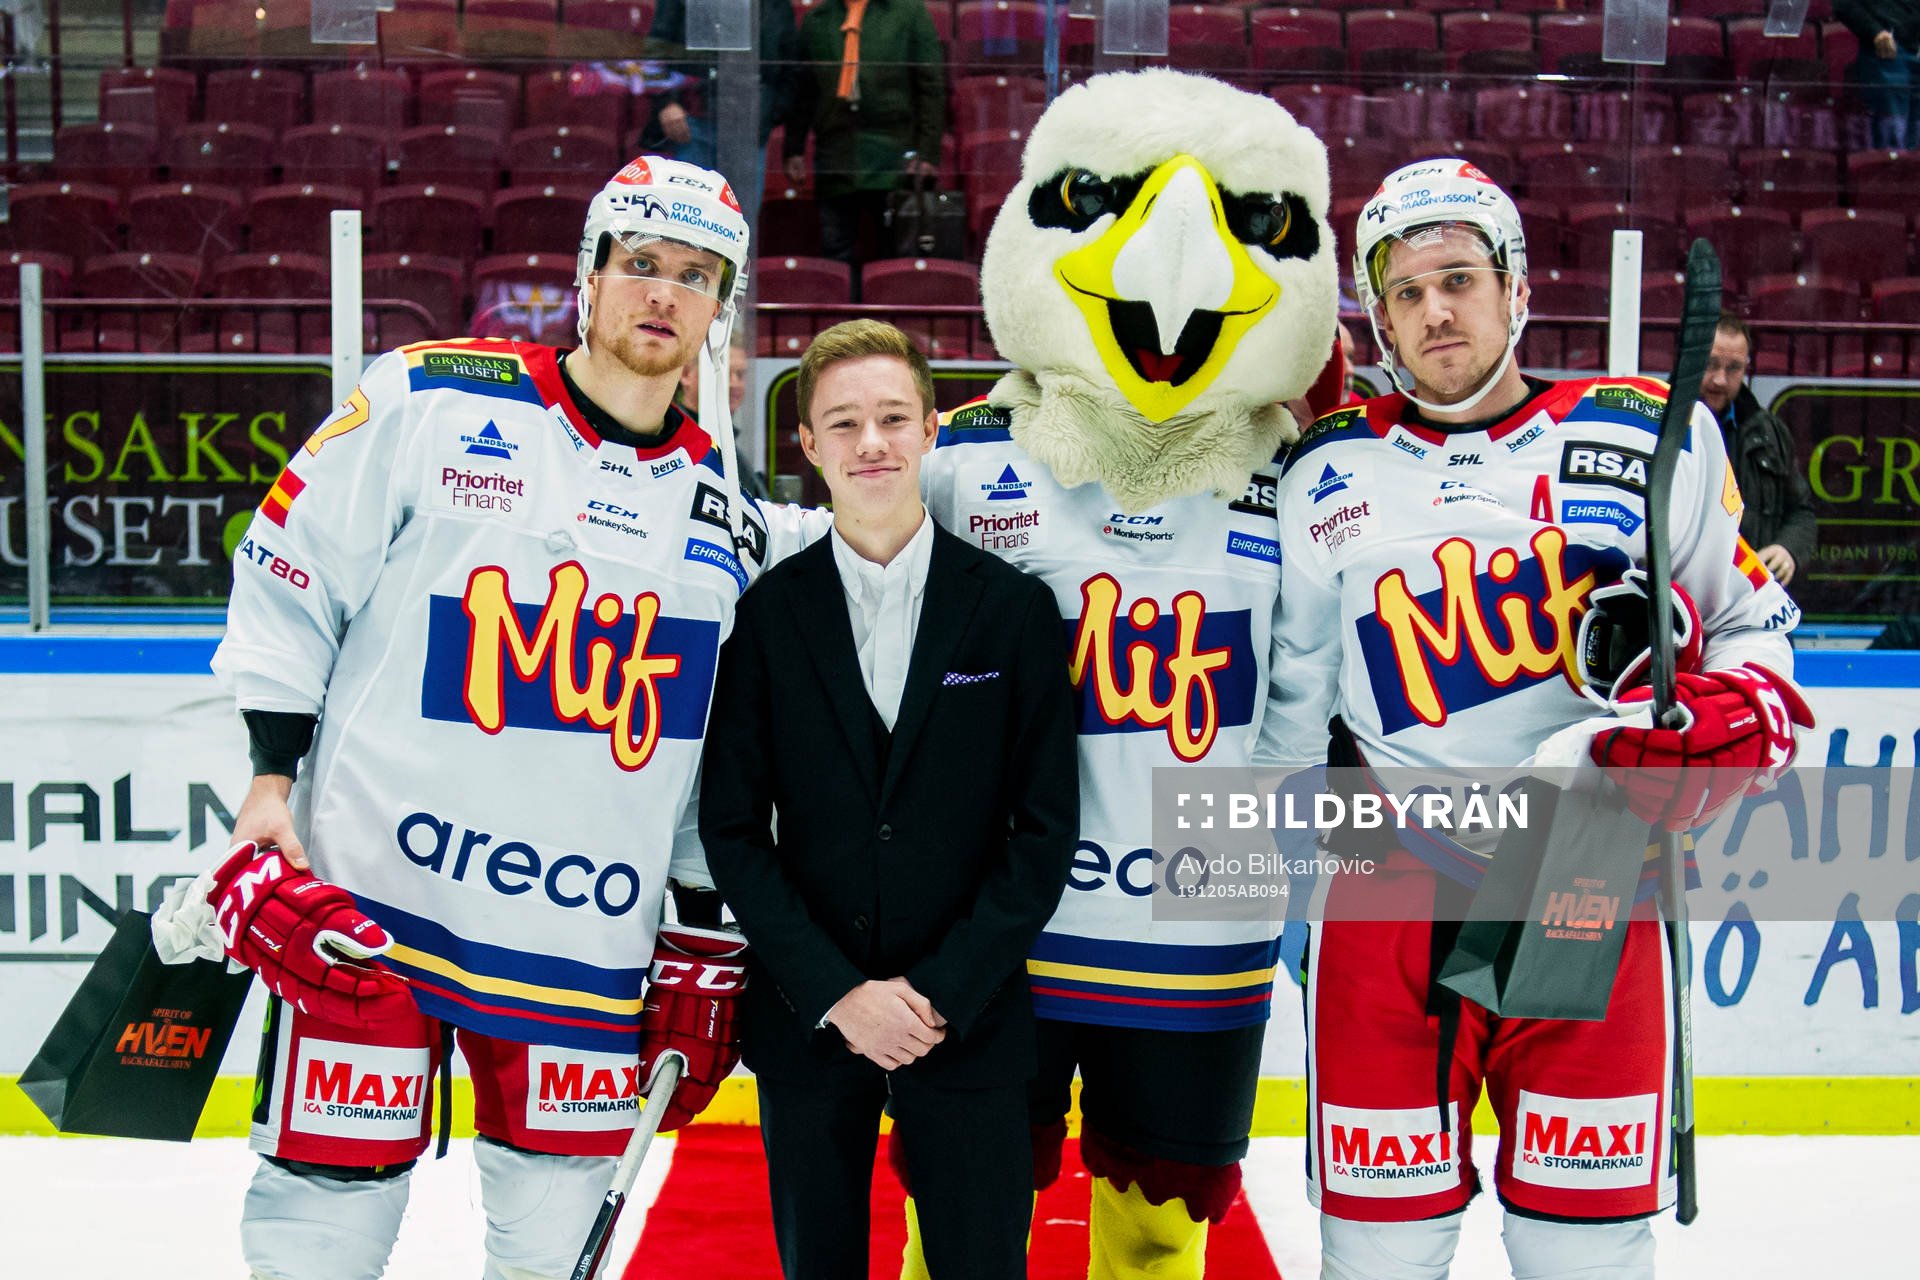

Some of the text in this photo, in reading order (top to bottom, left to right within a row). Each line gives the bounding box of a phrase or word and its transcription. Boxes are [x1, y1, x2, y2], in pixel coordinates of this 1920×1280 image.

[1400, 189, 1430, 203] OTTO
[1400, 194, 1477, 212] MAGNUSSON
[672, 202, 702, 217] OTTO
[669, 211, 736, 241] MAGNUSSON
[429, 355, 511, 371] GRÖNSAKS
[451, 364, 501, 380] HUSET
[460, 435, 519, 451] ERLANDSSON
[1394, 434, 1428, 457] bergx
[1506, 424, 1543, 450] bergx
[600, 460, 633, 477] SHL
[650, 457, 684, 478] bergx
[1447, 453, 1484, 467] SHL
[1569, 450, 1647, 485] RSA
[441, 468, 524, 497] Prioritet
[981, 481, 1032, 491] ERLANDSSON
[1307, 472, 1354, 497] ERLANDSSON
[452, 488, 512, 513] Finans
[1240, 482, 1277, 508] RS
[588, 500, 639, 520] CCM
[970, 510, 1039, 533] Prioritet
[1109, 514, 1164, 526] CCM
[1309, 501, 1370, 543] Prioritet
[981, 532, 1029, 550] Finans
[239, 536, 310, 590] AT80
[462, 560, 681, 772] Mif
[396, 812, 641, 917] areco
[216, 855, 282, 949] CM
[1541, 891, 1621, 930] HVEN
[650, 960, 748, 990] CC
[152, 1008, 178, 1018] SPIRIT
[115, 1022, 212, 1058] HVEN
[305, 1059, 424, 1108] MAXI
[539, 1062, 640, 1101] MAX
[303, 1102, 418, 1121] ICA STORMARKNAD
[538, 1102, 558, 1113] ICA
[1331, 1124, 1451, 1166] MAXI
[1523, 1111, 1646, 1157] MAXI
[1333, 1162, 1451, 1179] ICA STORMARKNAD
[1523, 1152, 1643, 1170] ICA STORMARKNAD
